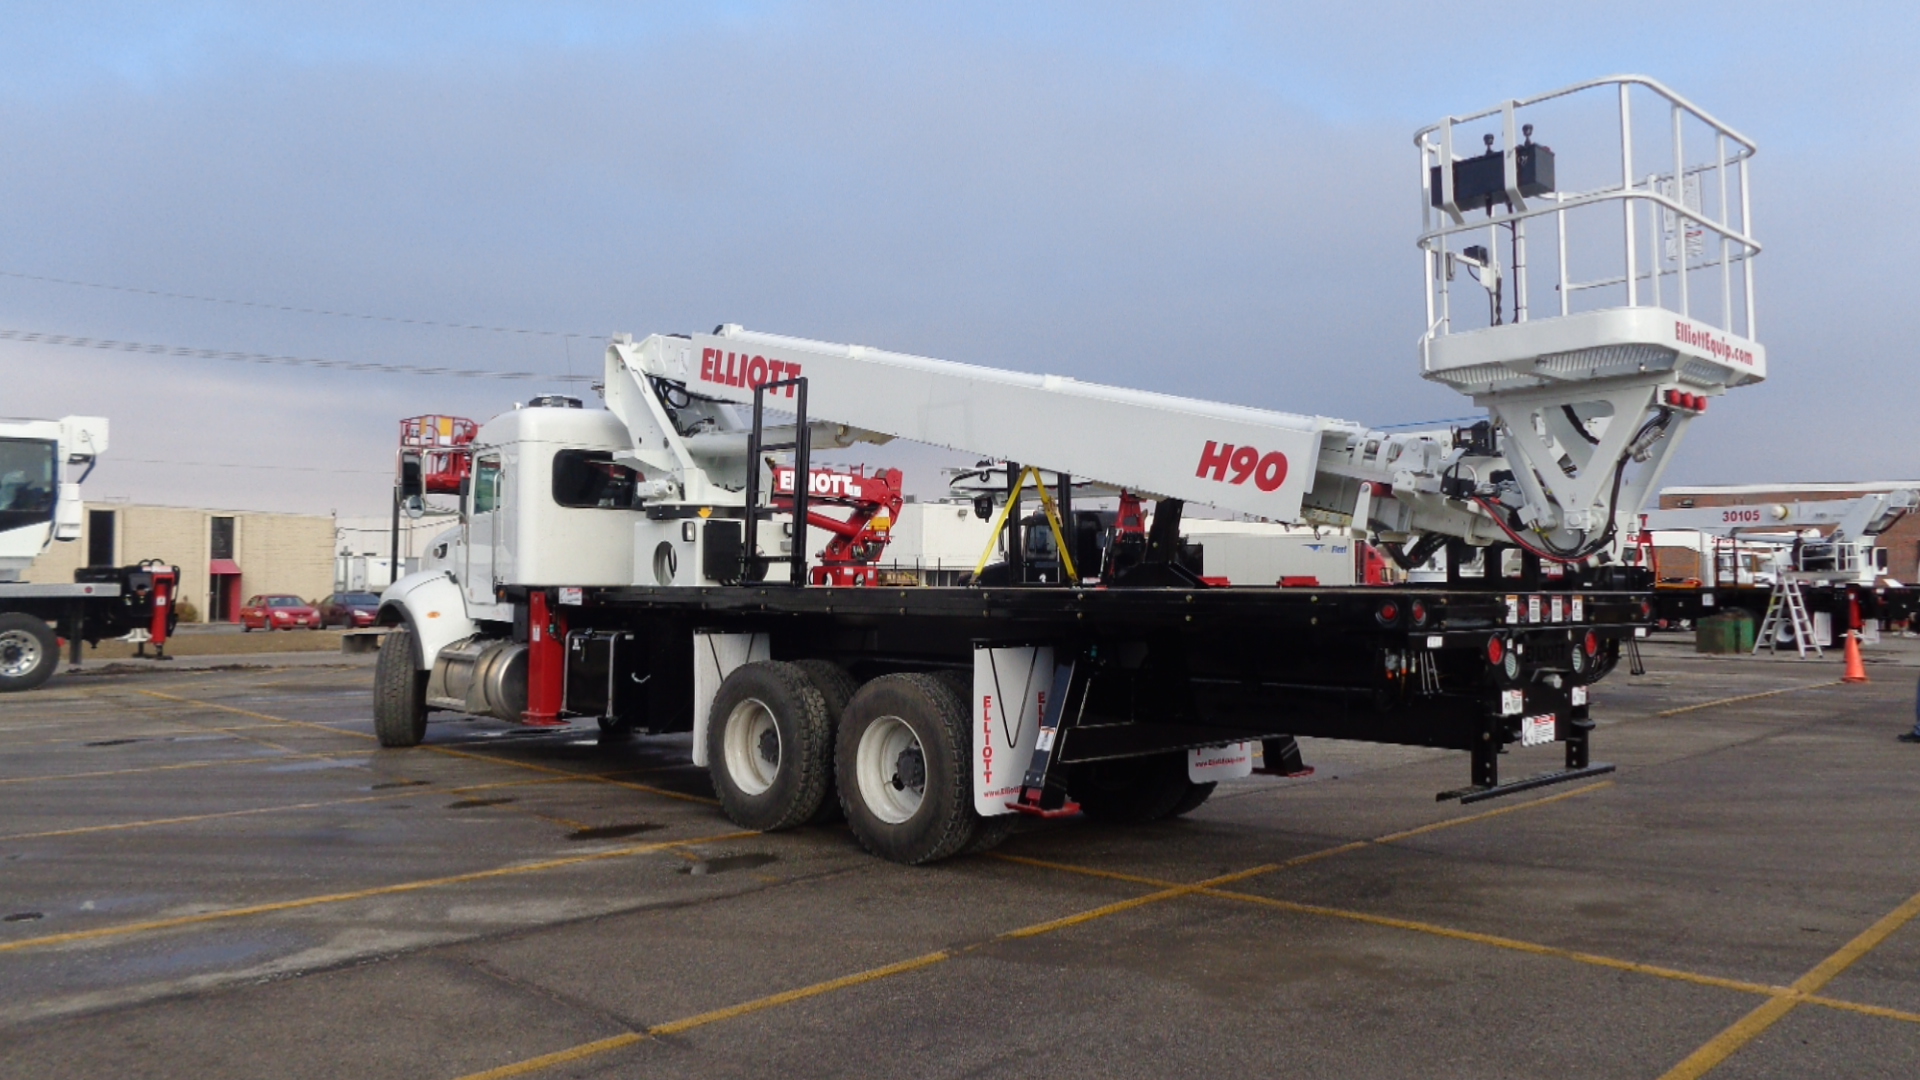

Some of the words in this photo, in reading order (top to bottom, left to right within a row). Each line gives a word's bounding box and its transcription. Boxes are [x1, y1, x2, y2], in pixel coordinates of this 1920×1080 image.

[1675, 320, 1754, 366] ElliottEquip.com
[700, 347, 802, 399] ELLIOTT
[1195, 440, 1288, 492] H90
[1722, 510, 1760, 521] 30105
[983, 695, 993, 784] ELLIOTT
